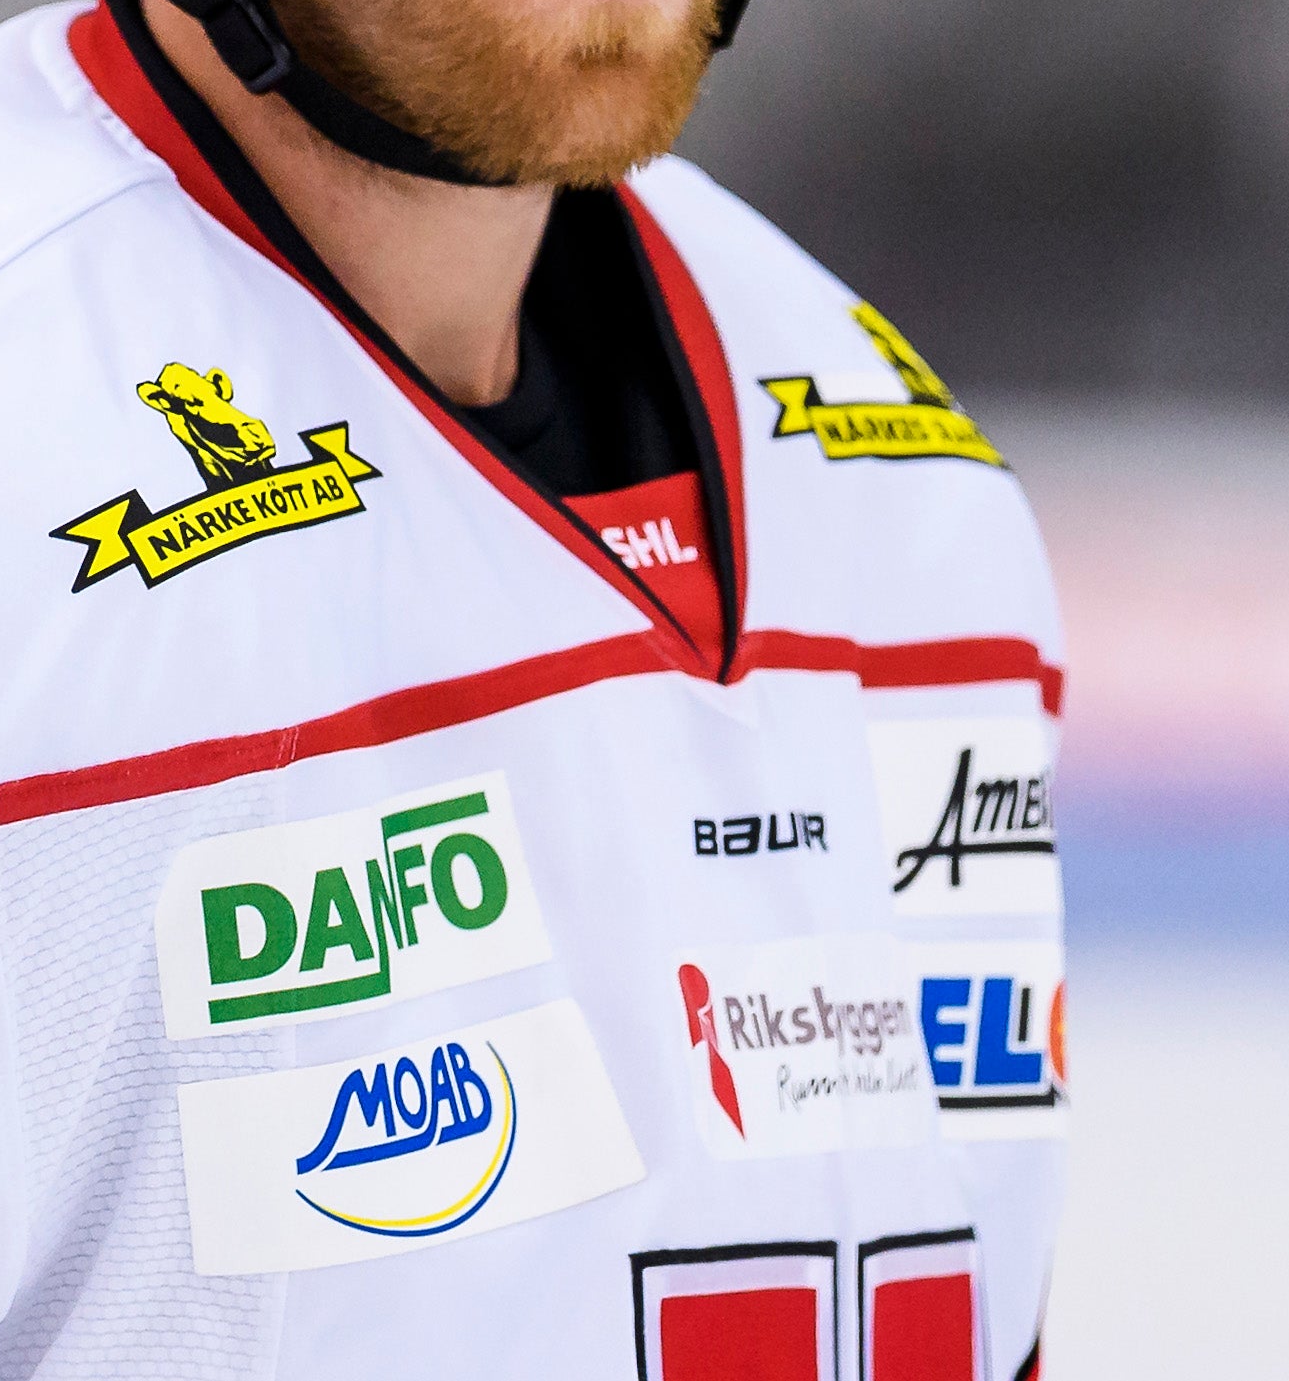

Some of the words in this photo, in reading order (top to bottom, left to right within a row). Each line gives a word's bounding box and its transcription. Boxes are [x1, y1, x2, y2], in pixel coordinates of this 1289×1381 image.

[147, 498, 256, 561] NÄRKE
[251, 481, 309, 519] KÖTT
[312, 475, 344, 505] AB
[600, 516, 699, 570] SHL
[694, 811, 828, 856] BAUR
[201, 791, 508, 1024] DANFO
[296, 1042, 492, 1176] MOAB
